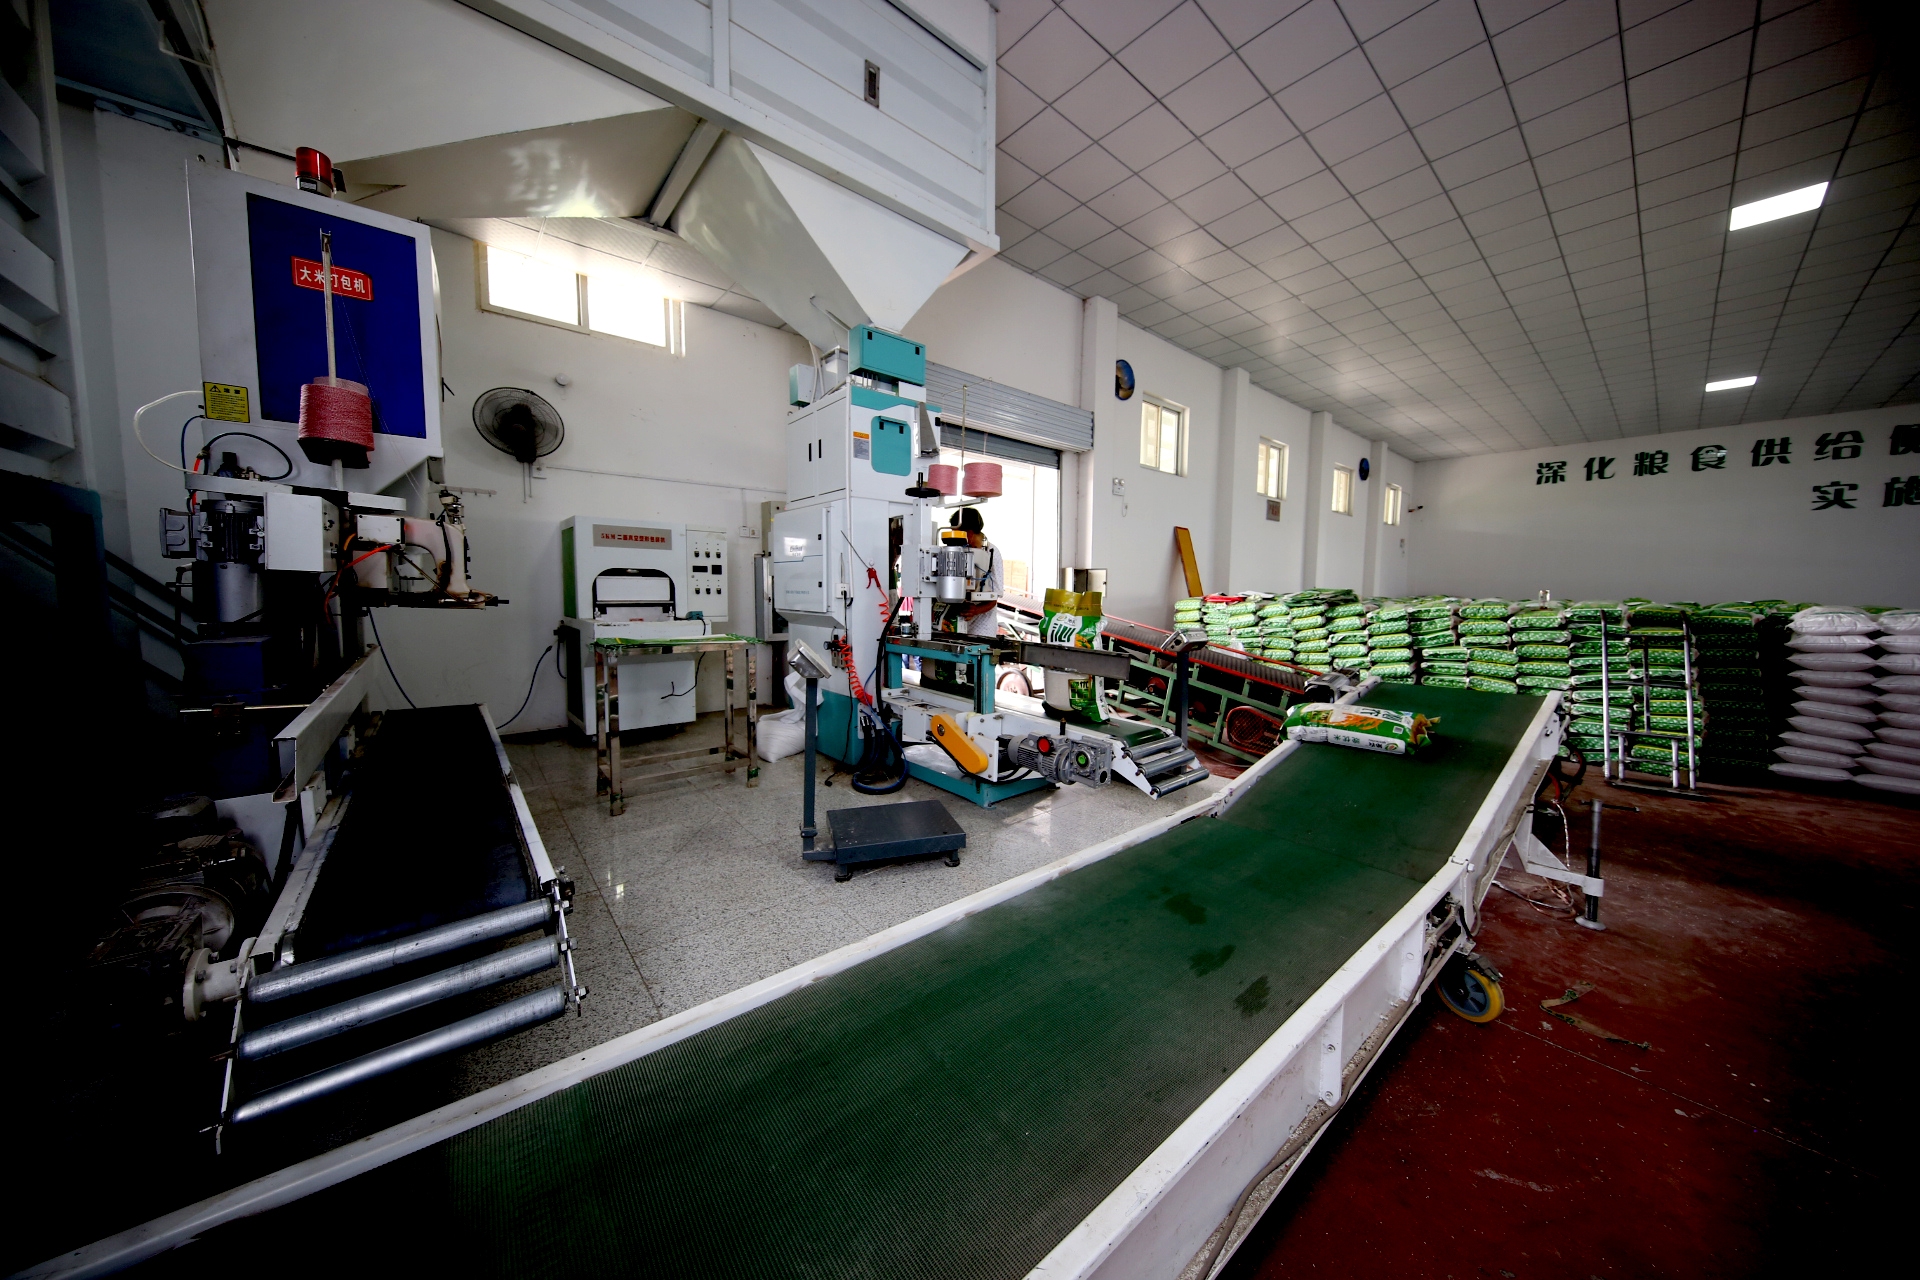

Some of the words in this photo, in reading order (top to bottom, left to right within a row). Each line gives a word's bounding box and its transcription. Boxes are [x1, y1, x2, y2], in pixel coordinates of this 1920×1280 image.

[300, 265, 366, 293] 大米打包机
